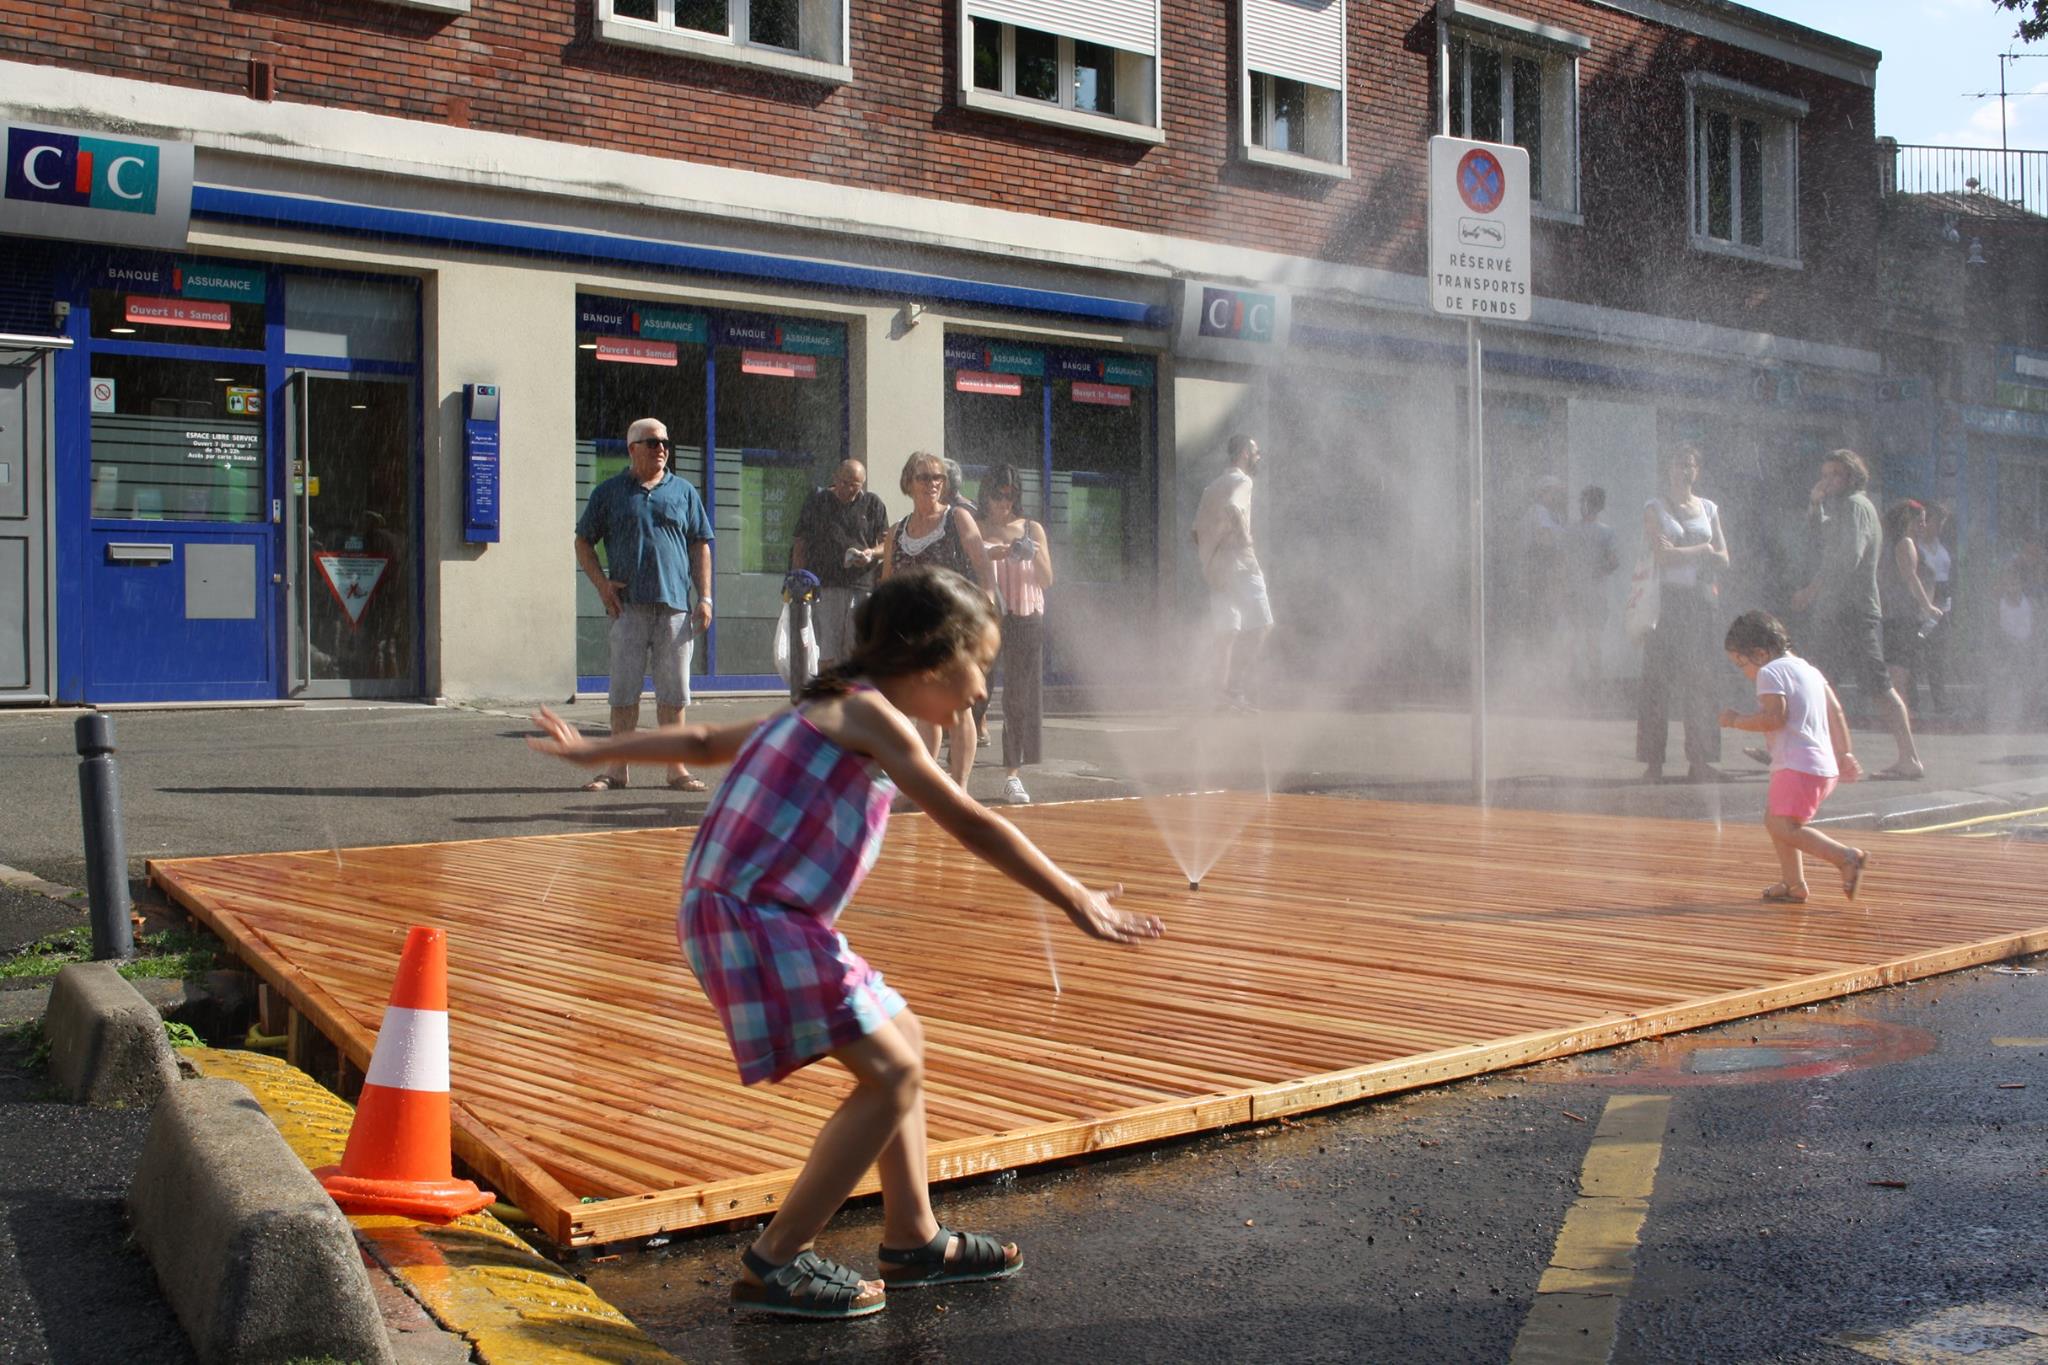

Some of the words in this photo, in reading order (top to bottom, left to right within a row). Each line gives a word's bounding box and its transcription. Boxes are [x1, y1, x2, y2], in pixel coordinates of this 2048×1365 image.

[23, 145, 145, 200] CIC
[1450, 252, 1512, 273] RÉSERVÉ
[108, 268, 160, 282] BANQUE
[187, 276, 251, 291] ASSURANCE
[1437, 273, 1525, 295] TRANSPORTS
[130, 305, 169, 317] Ouvert
[174, 308, 184, 319] le
[190, 310, 228, 322] Samedi
[1446, 296, 1463, 310] DE
[1472, 298, 1517, 315] FONDS
[583, 312, 623, 325] BANQUE
[643, 319, 694, 332] ASSURANCE
[1208, 298, 1270, 333] CIC
[729, 327, 766, 339] BANQUE
[784, 333, 831, 346] ASSURANCE
[599, 345, 629, 355] Ouvert
[633, 347, 641, 356] le
[645, 348, 675, 359] Samedi
[945, 349, 977, 360] BANQUE
[992, 355, 1033, 366] ASSURANCE
[1062, 361, 1092, 372] BANQUE
[1106, 367, 1143, 377] ASSURANCE
[186, 432, 209, 440] ESPACE
[212, 433, 229, 441] LIBRE
[232, 434, 258, 442] SERVICE
